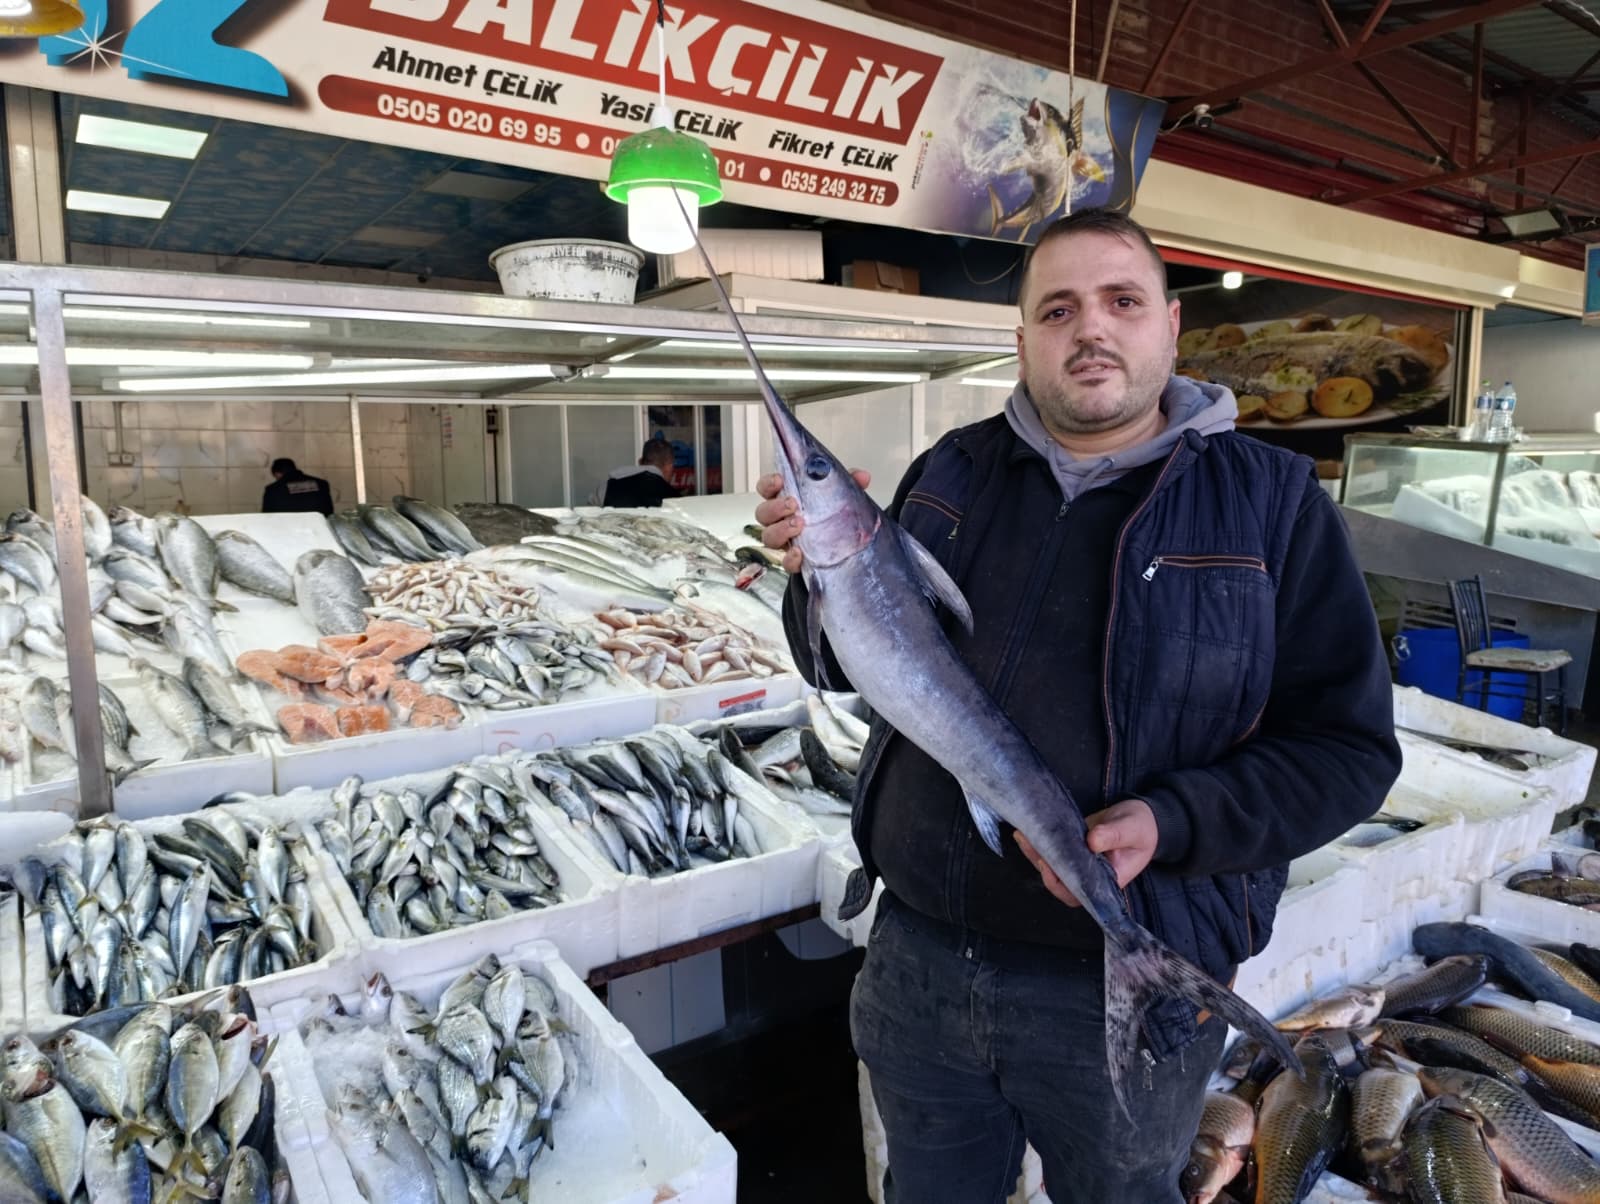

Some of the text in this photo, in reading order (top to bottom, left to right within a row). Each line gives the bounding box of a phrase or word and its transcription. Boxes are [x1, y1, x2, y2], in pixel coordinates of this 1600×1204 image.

[372, 46, 477, 87] Ahmet
[600, 92, 656, 123] Yasi
[768, 130, 834, 159] Fikret
[377, 94, 441, 124] 0505
[448, 108, 493, 133] 020
[499, 117, 528, 139] 69
[534, 127, 561, 146] 95
[724, 159, 745, 179] 01
[781, 169, 817, 193] 0535
[820, 176, 847, 199] 249
[849, 182, 867, 201] 32
[870, 185, 886, 204] 75
